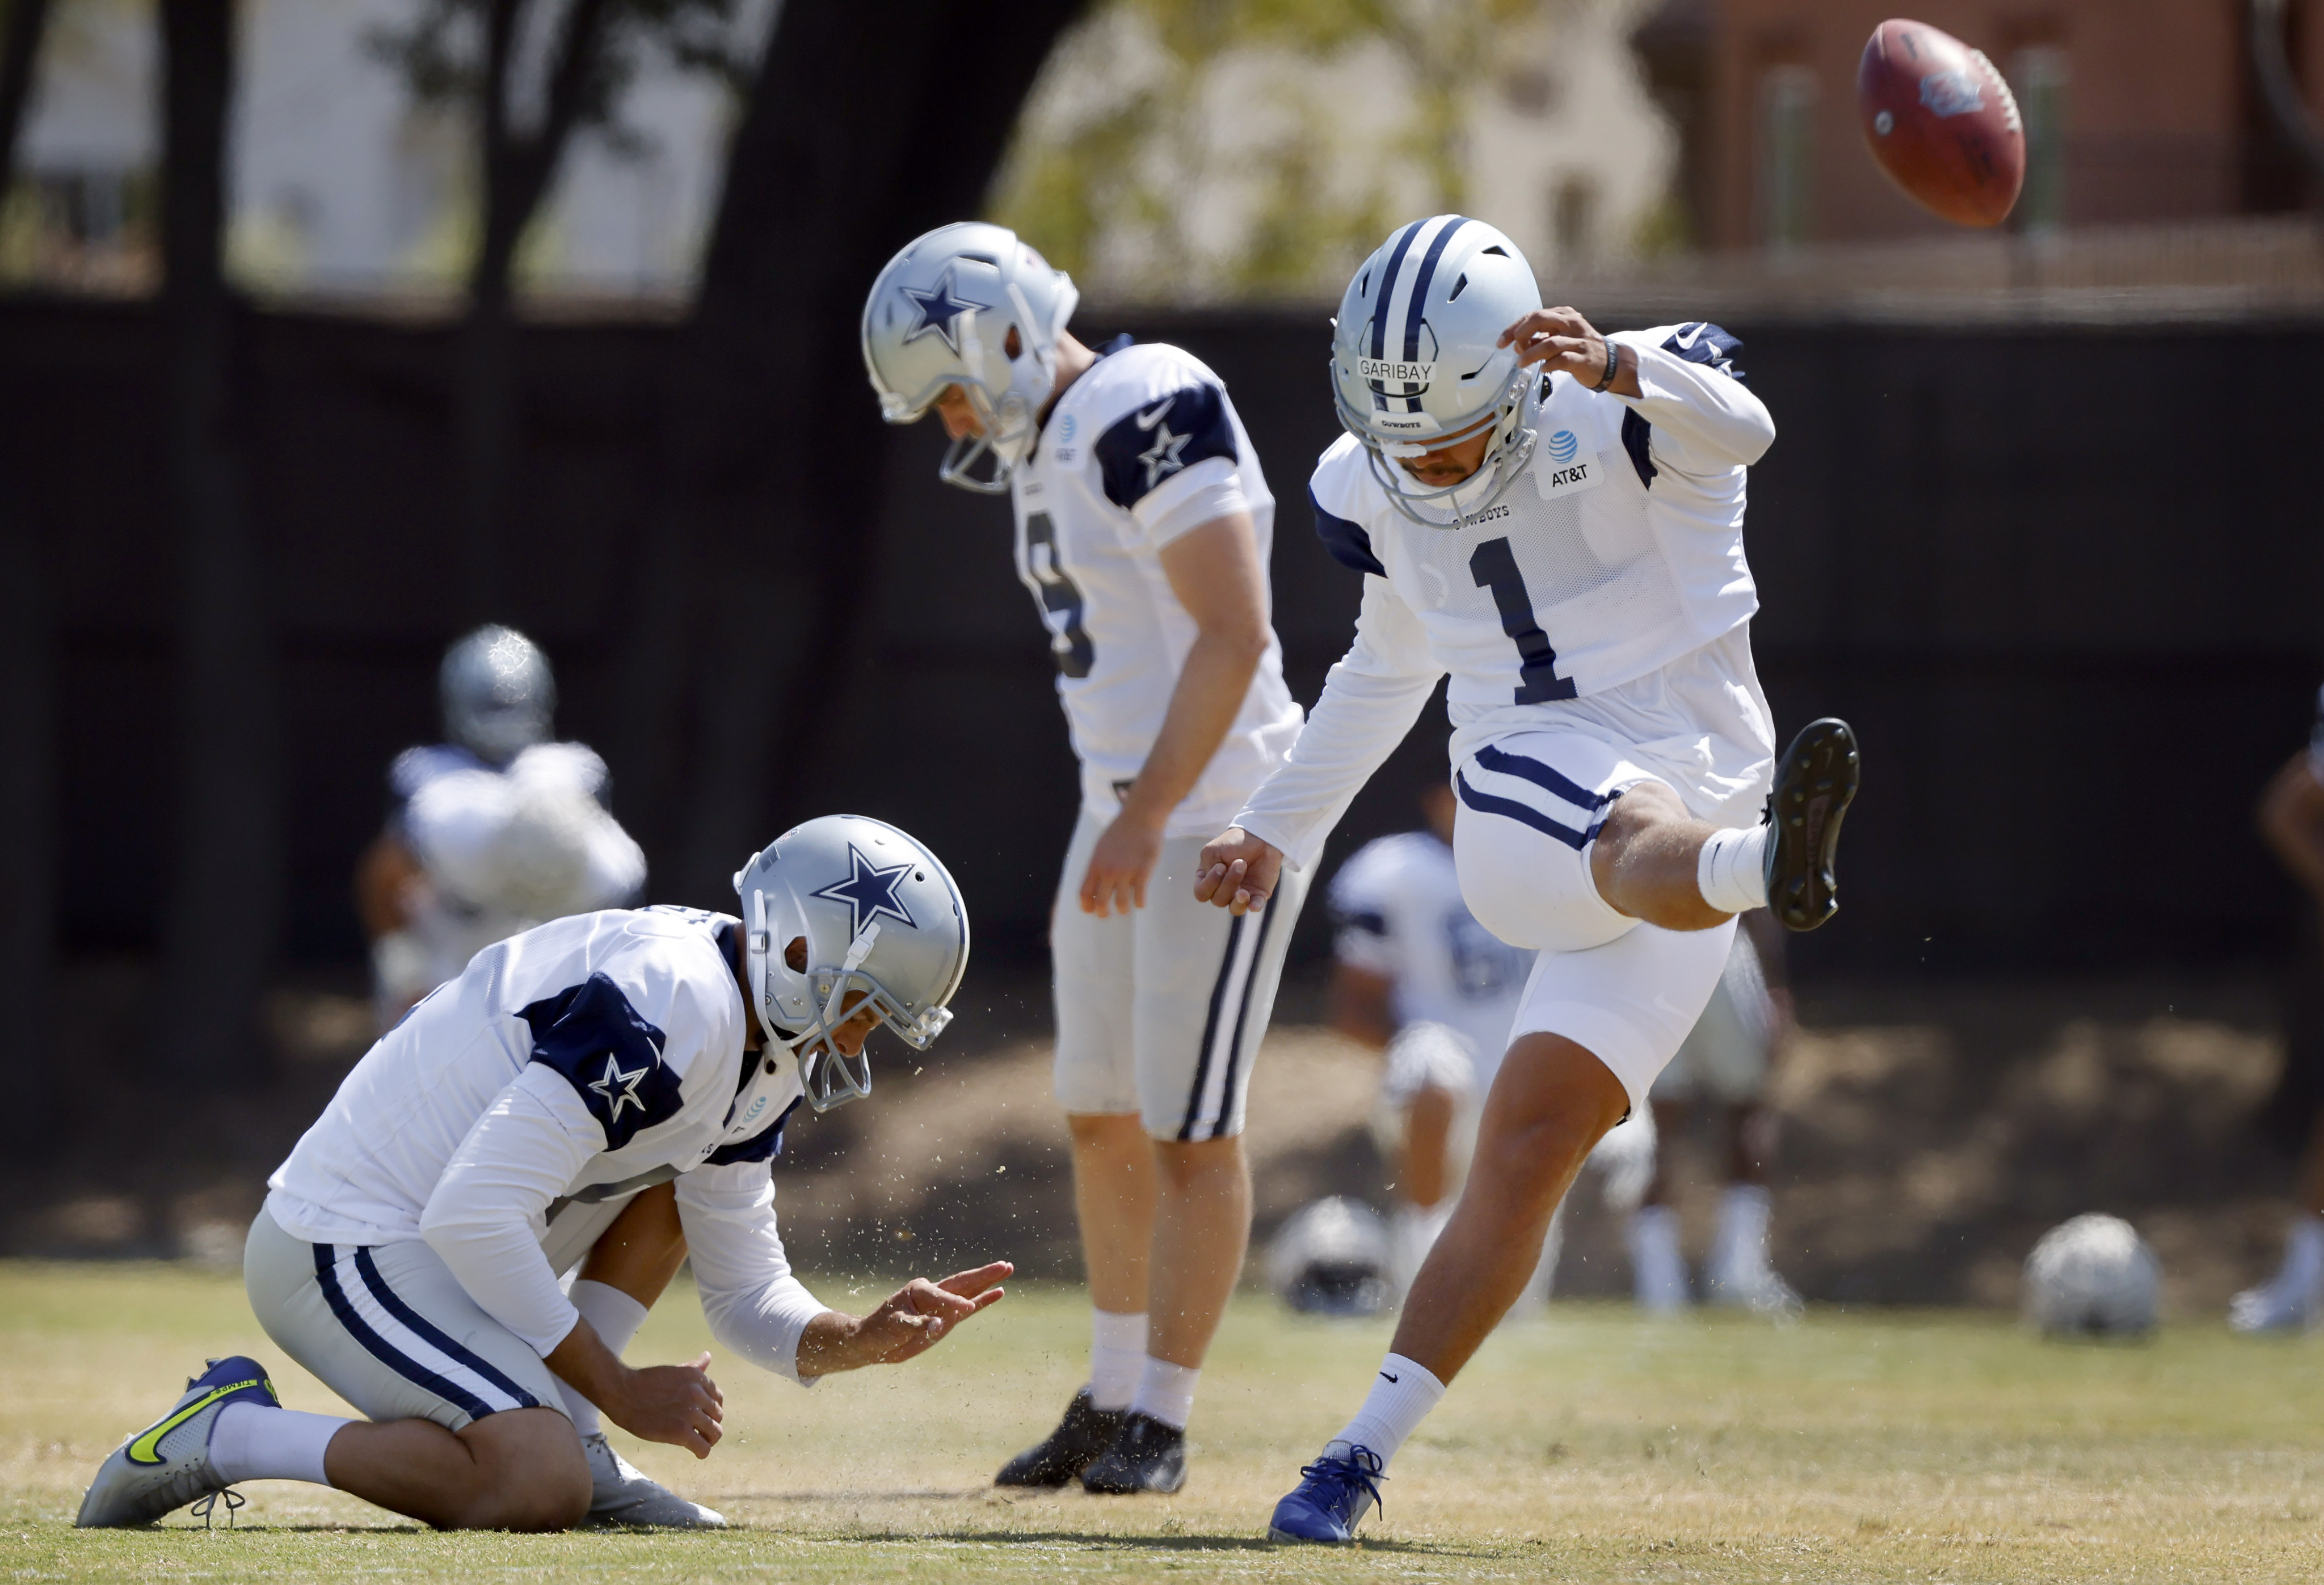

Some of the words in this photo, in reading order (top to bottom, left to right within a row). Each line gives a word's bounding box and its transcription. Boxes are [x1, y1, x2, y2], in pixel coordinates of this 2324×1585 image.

[1361, 360, 1432, 380] GARIBAY
[1382, 420, 1421, 428] COWBOYS
[1552, 464, 1587, 488] AT&T
[1469, 536, 1579, 706] 1
